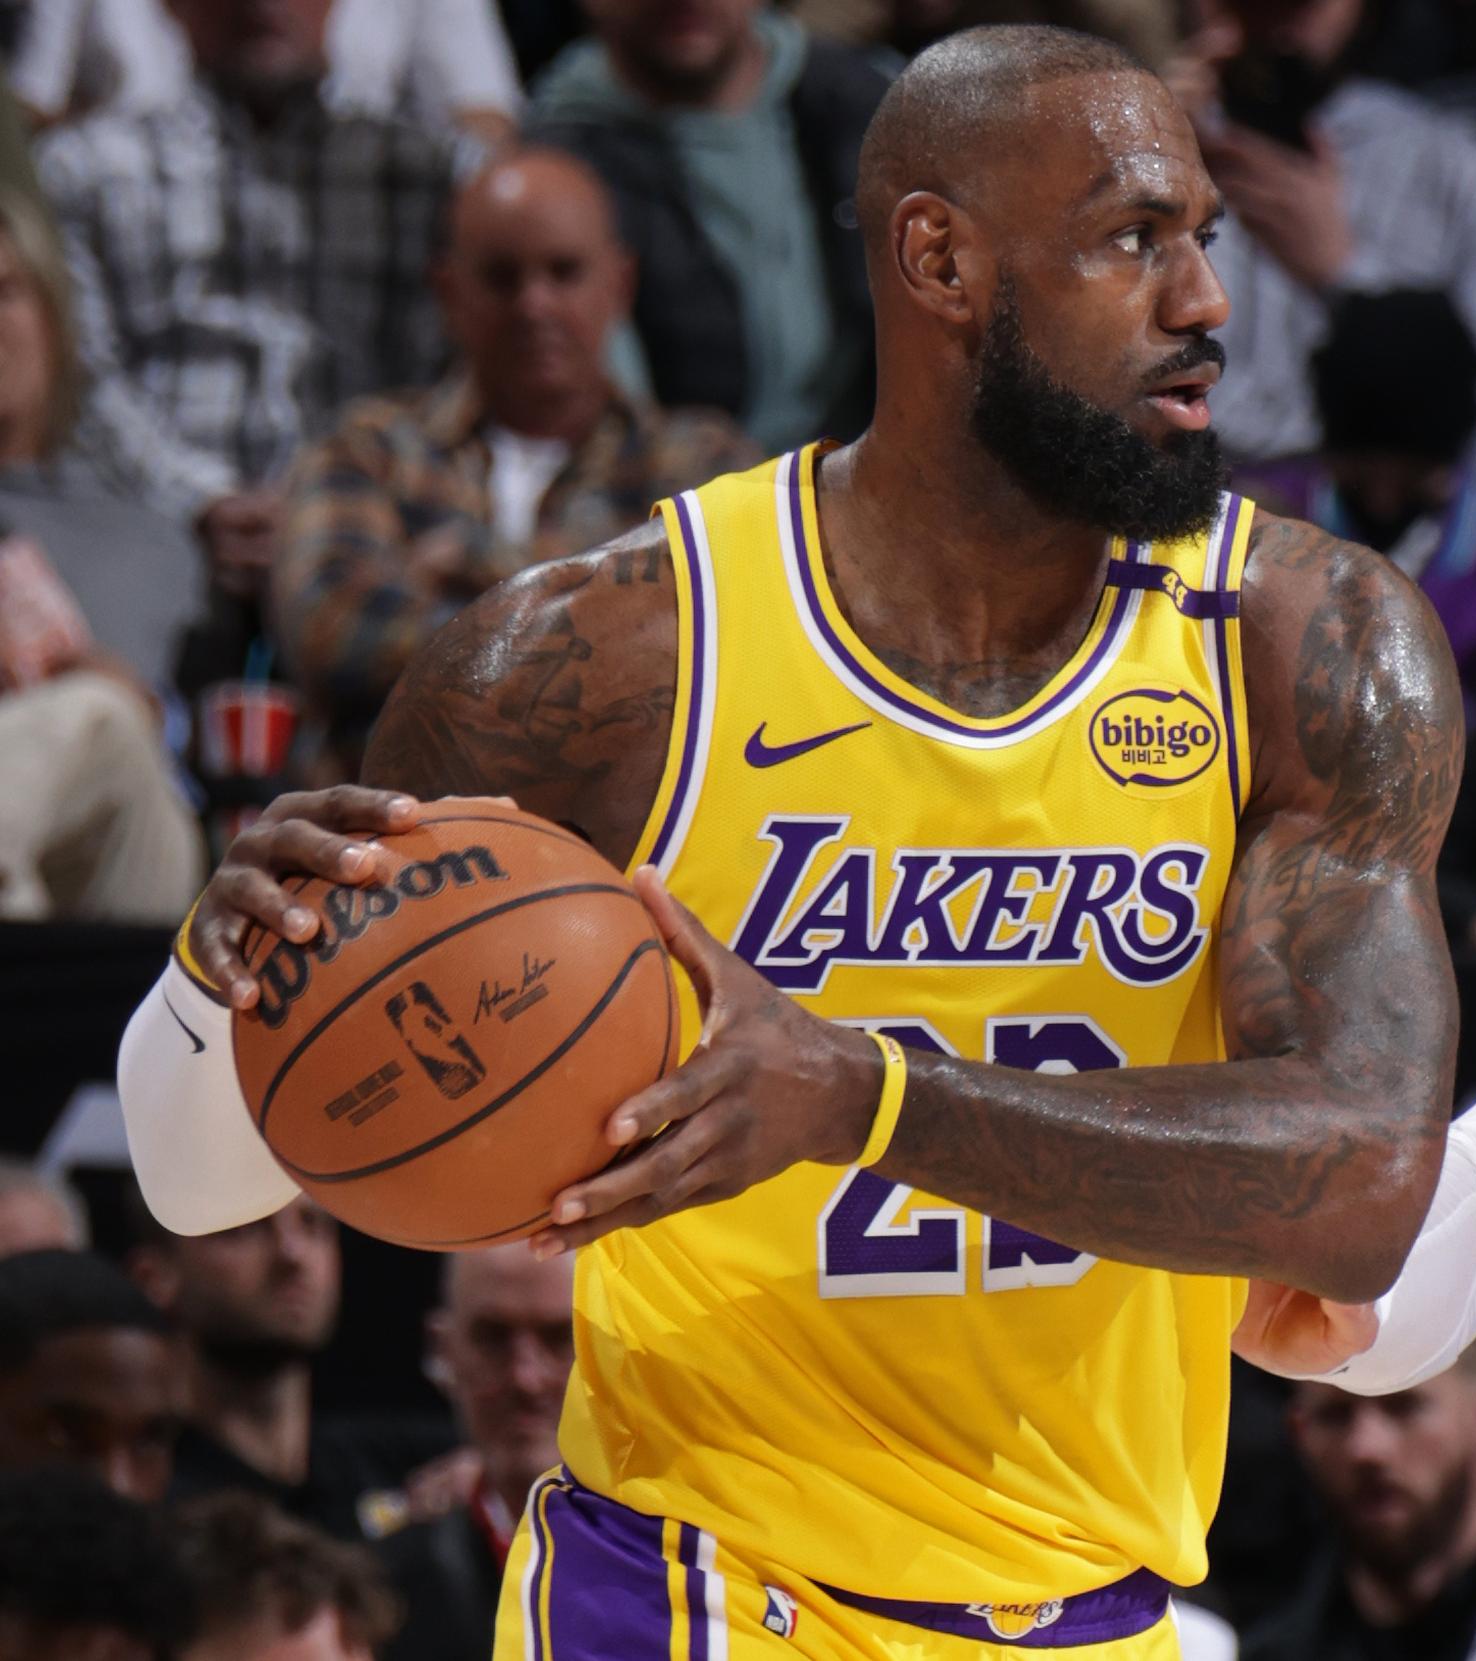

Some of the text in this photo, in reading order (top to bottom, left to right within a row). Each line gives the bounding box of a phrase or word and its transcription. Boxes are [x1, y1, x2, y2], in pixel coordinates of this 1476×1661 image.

[1102, 714, 1211, 758] bibigo
[1121, 749, 1167, 765] 비비고
[730, 814, 1210, 994] LAKERS
